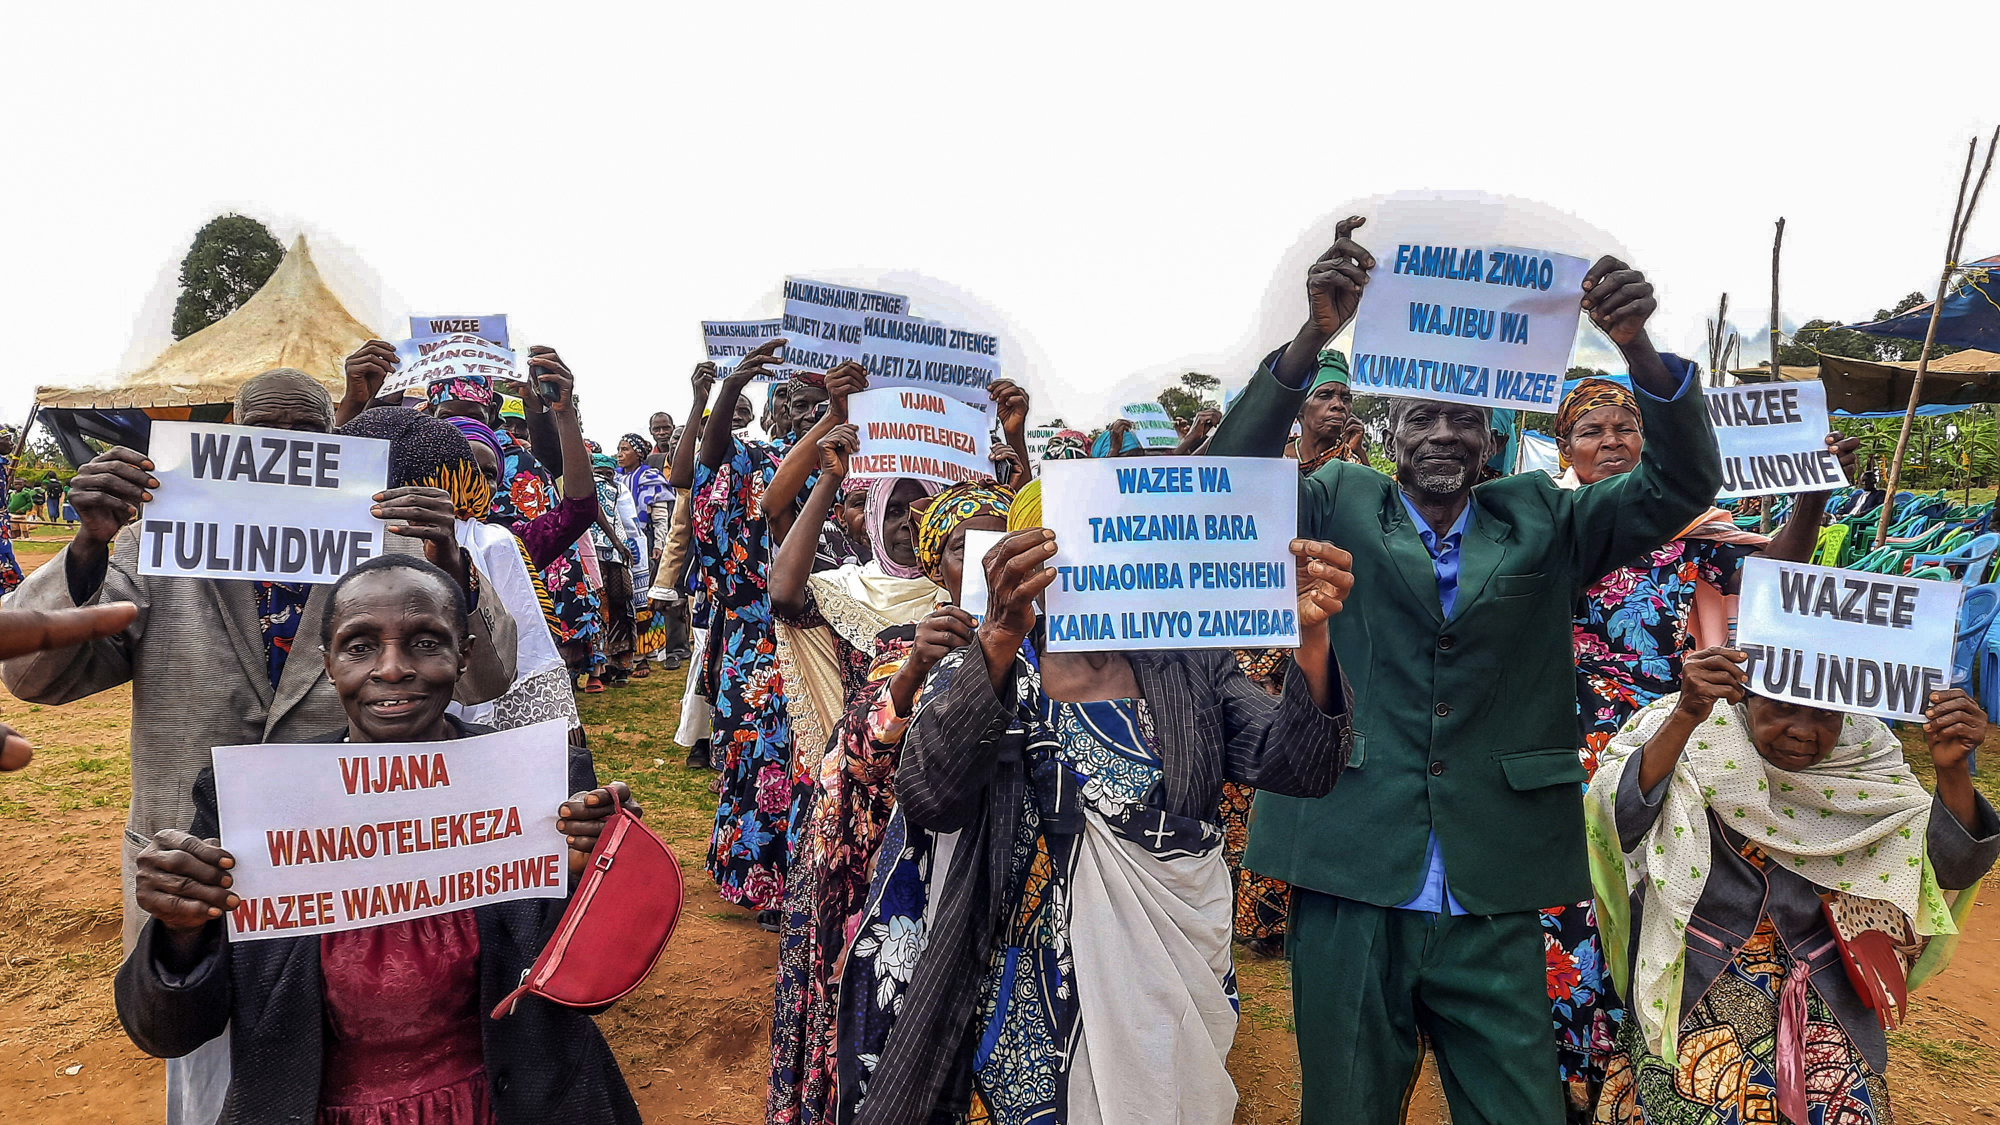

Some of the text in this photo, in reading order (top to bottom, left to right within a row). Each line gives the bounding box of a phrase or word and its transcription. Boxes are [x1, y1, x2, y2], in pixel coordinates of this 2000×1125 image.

[1393, 244, 1554, 292] FAMILIA ZINAO
[783, 280, 902, 315] HALMASHAURI ZITENGE
[430, 320, 480, 333] WAZEE
[703, 324, 760, 336] HALMASHAURI
[782, 312, 820, 338] BAJETI
[822, 322, 836, 341] ZA
[864, 317, 997, 356] HALMASHAURI ZITENGE
[1409, 301, 1529, 345] WAJIBU WA
[708, 345, 736, 356] BAJETI
[463, 363, 522, 379] YETU
[862, 353, 993, 389] BAJETI ZA KUENDESHA
[1352, 353, 1557, 404] KUWATUNZA WAZEE
[900, 392, 946, 415] VIJANA
[1703, 388, 1802, 427] WAZEE
[868, 422, 976, 455] WANAOTELEKEZA
[190, 432, 341, 489] WAZEE
[851, 454, 896, 473] WAZEE
[1722, 450, 1840, 491] ULINDWE
[1116, 467, 1231, 493] WAZEE WA
[1089, 515, 1258, 543] TANZANIA BARA
[145, 520, 372, 575] TULINDWE
[1058, 562, 1285, 592] TUNAOMBA PENSHENI
[1779, 567, 1920, 629] WAZEE
[1049, 609, 1296, 641] KAMA ILIVYO ZANZIBAR
[1740, 643, 1944, 715] TULINDWE
[338, 753, 450, 795] VIJANA
[266, 806, 522, 867] WANAOTELEKEZA
[232, 854, 560, 933] WAZEE WAWAJIBISHWE
